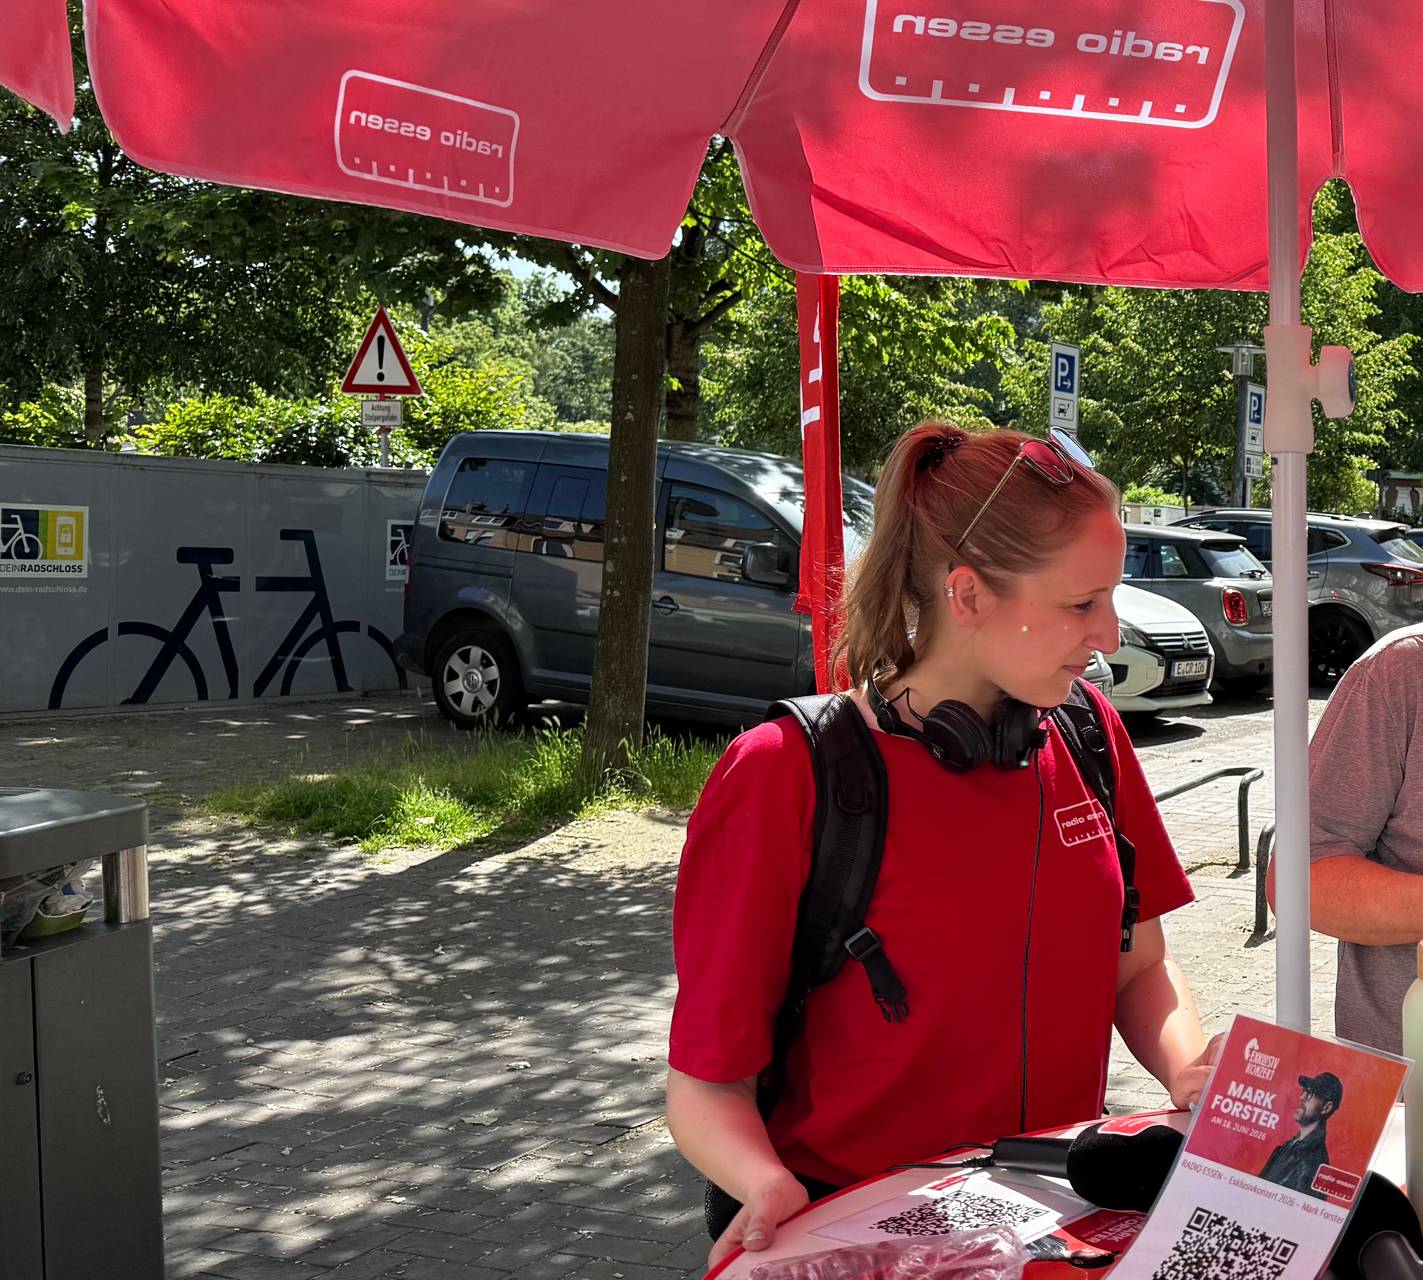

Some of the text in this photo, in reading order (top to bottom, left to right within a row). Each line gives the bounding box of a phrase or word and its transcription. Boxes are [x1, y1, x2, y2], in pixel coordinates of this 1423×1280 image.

[1057, 357, 1069, 387] P
[1061, 816, 1085, 829] radio
[1245, 1062, 1275, 1081] KONZERT
[1250, 1050, 1280, 1069] EXKLUSIV
[1227, 1081, 1277, 1110] MARK
[1210, 1094, 1280, 1130] FORSTER
[1211, 1116, 1223, 1125] AM
[1232, 1122, 1249, 1134] JUNI
[1249, 1128, 1267, 1140] 2026
[1181, 1158, 1202, 1173] RADIO
[1202, 1165, 1223, 1180] ESSEN
[1228, 1176, 1278, 1200] Exklusivkonzert
[1278, 1191, 1295, 1207] 2026
[1301, 1202, 1318, 1216] Mark
[1319, 1208, 1345, 1224] Forster
